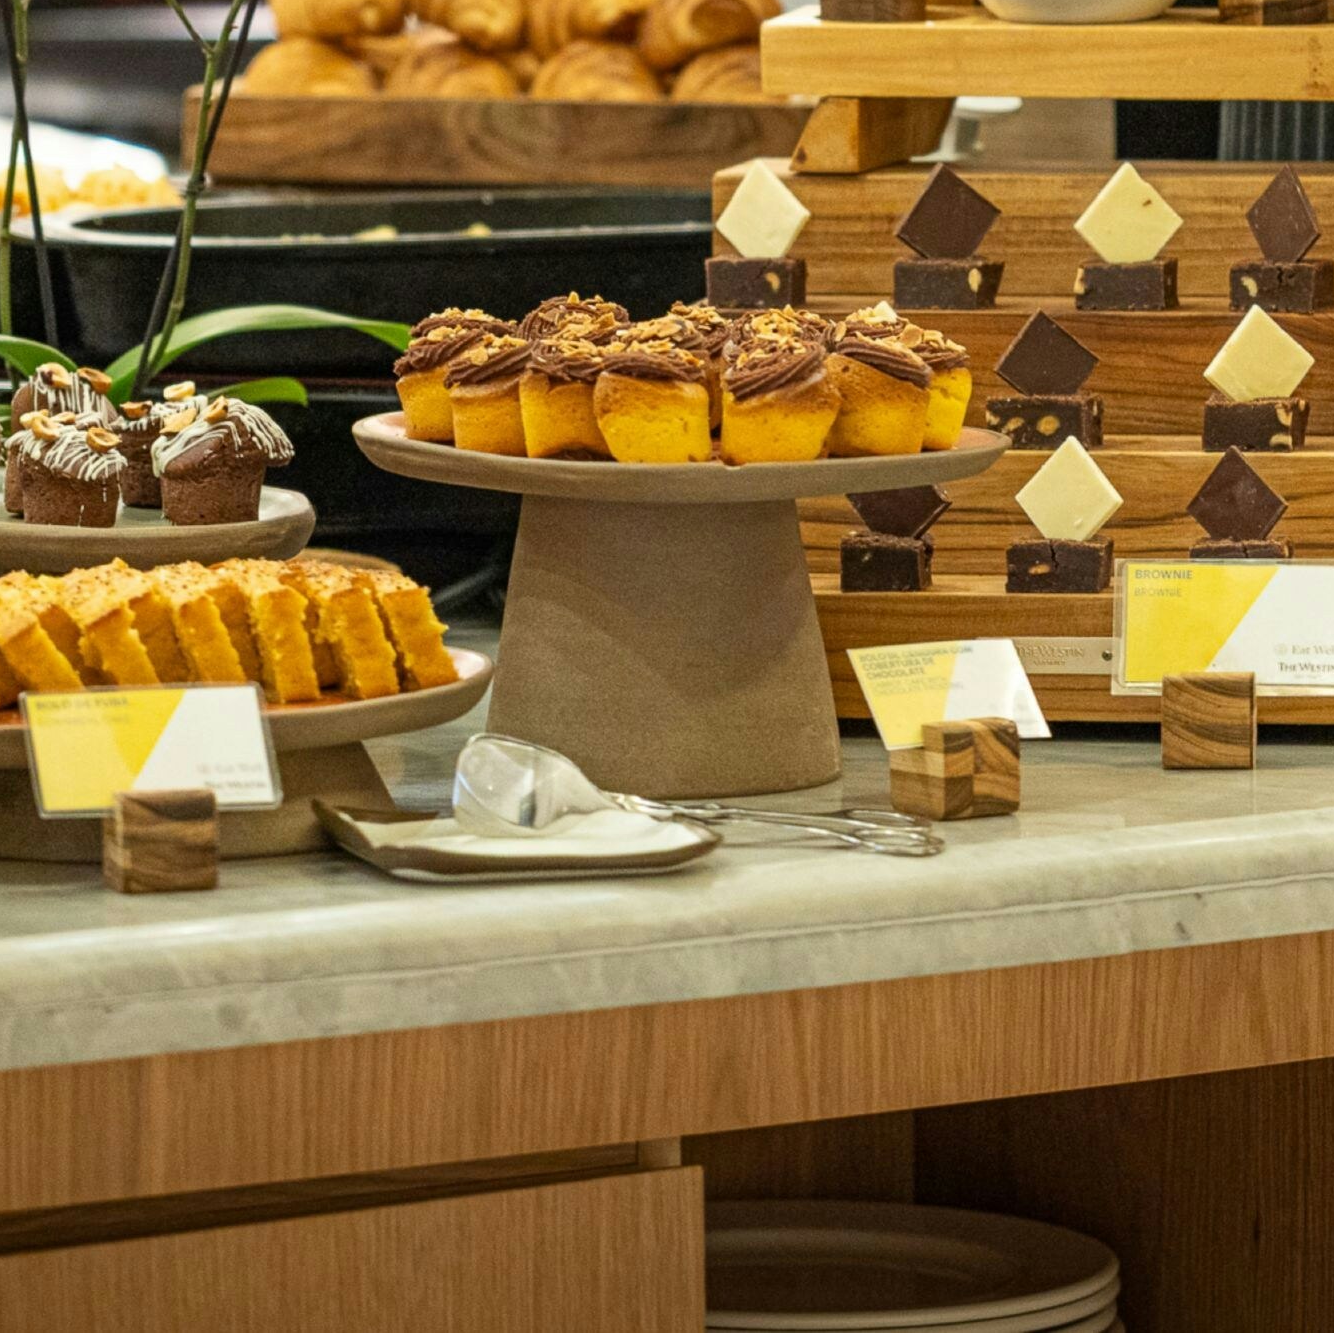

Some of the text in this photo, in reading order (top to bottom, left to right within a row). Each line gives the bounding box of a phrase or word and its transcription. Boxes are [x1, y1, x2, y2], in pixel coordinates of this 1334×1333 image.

[1135, 570, 1193, 579] BROWNIE
[1135, 587, 1182, 597] BROWNIE
[1292, 645, 1310, 655] Eat
[1277, 661, 1296, 671] THE
